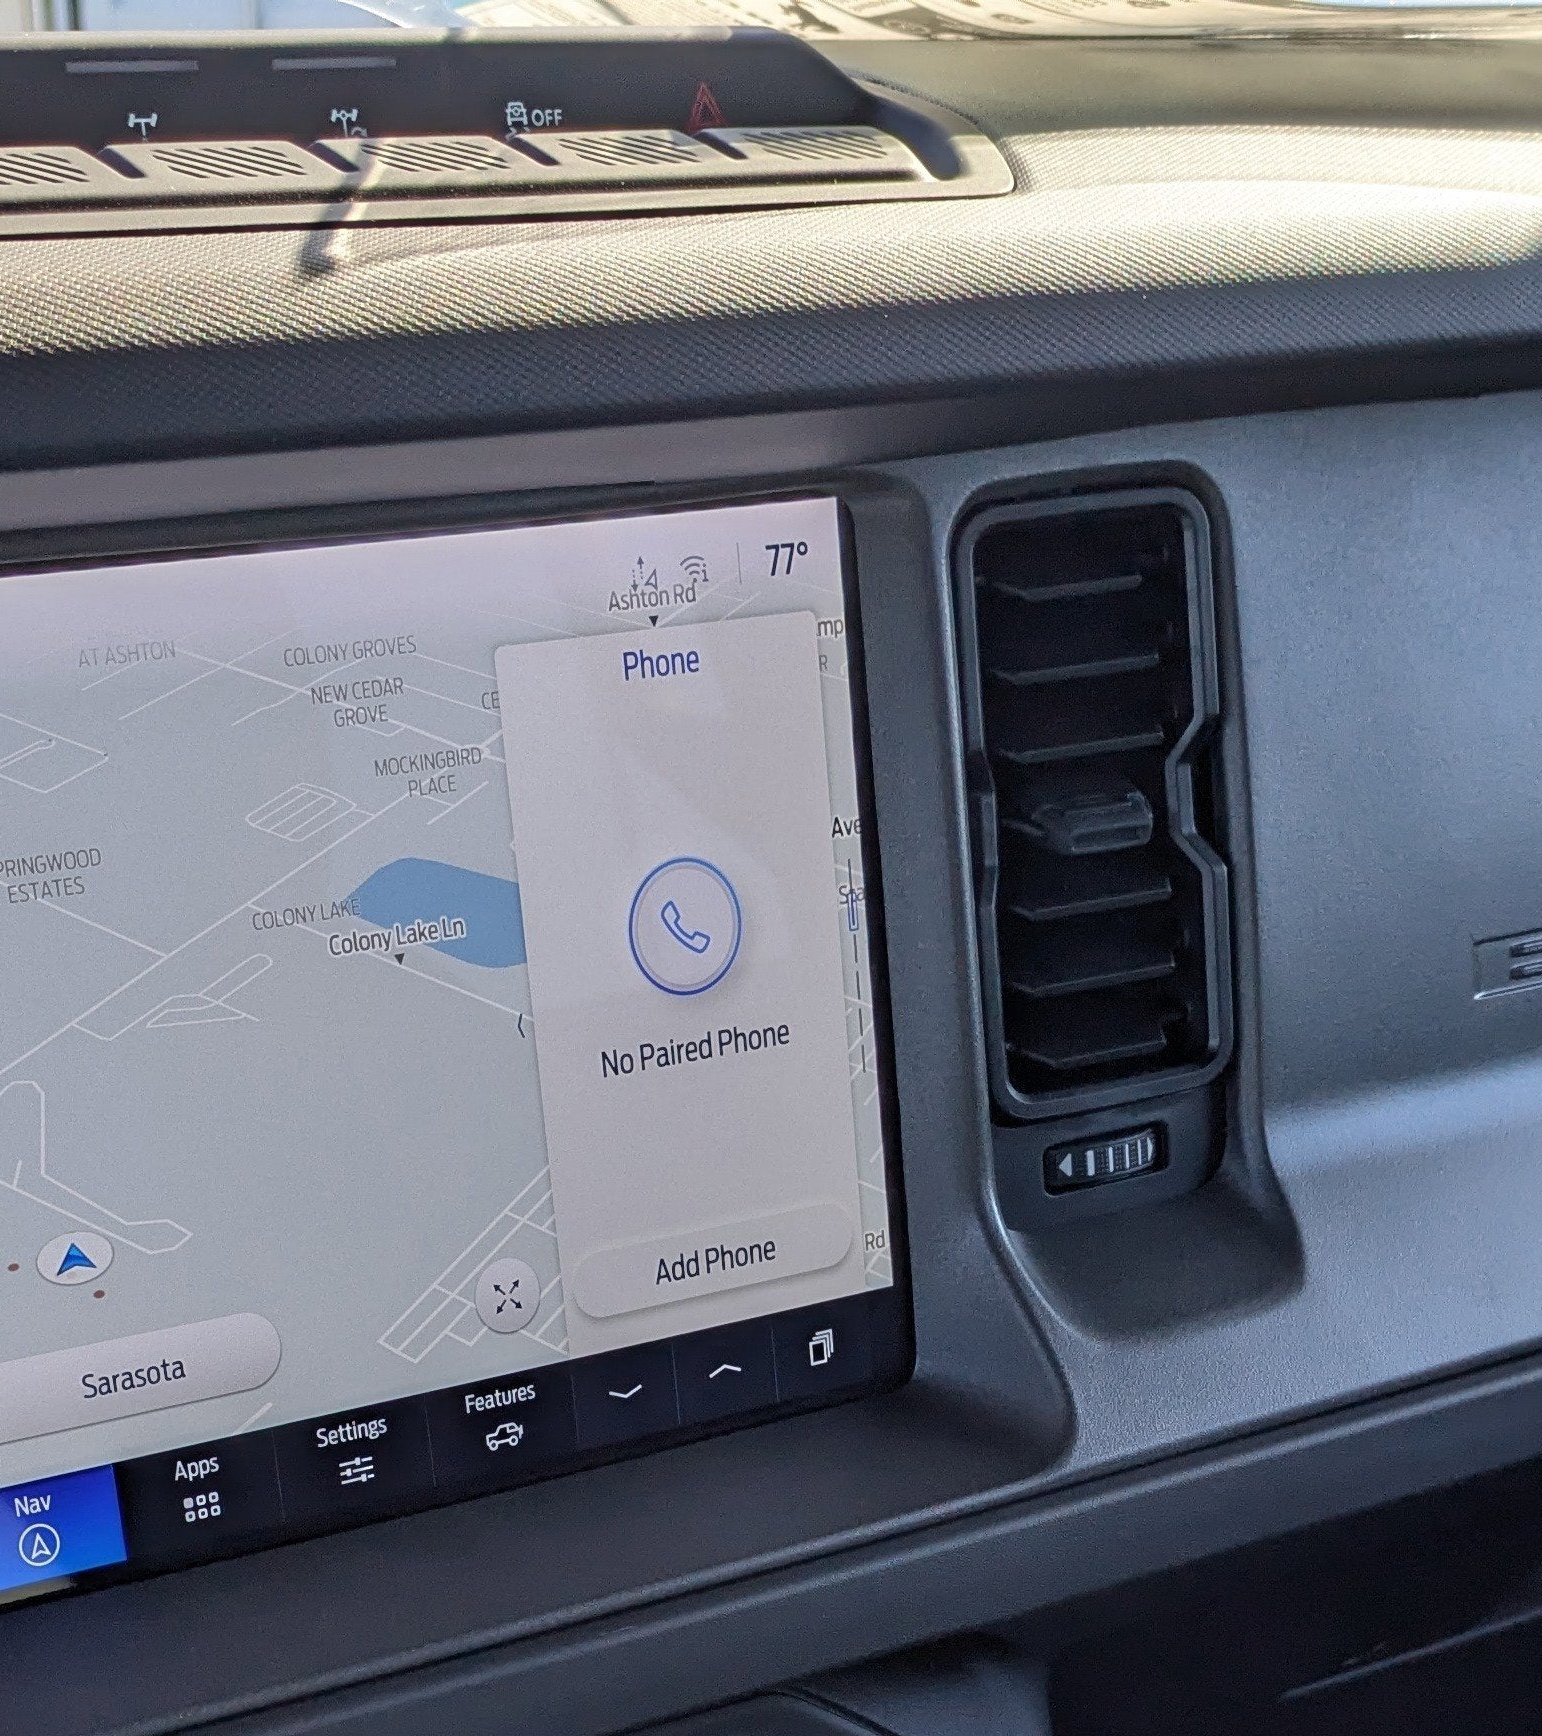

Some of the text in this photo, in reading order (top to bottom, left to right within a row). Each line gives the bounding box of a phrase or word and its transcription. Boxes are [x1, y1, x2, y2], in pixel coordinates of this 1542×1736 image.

[532, 108, 563, 127] OFF
[608, 582, 697, 612] Ashton Rd
[78, 640, 177, 668] AT ASHTON
[283, 634, 418, 667] COLONY GROVES
[622, 648, 701, 681] Phone
[310, 677, 405, 705] NEW CEDAR
[333, 702, 390, 728] GROVE
[373, 746, 483, 778] MOCKINGBIRD
[406, 774, 458, 799] PLACE
[6, 875, 87, 904] ESTATES
[252, 897, 362, 932] COLONY LAKE
[328, 916, 466, 957] Colony Lake Ln
[601, 1022, 791, 1079] No Paired Phone
[864, 1229, 886, 1252] Rd
[655, 1240, 777, 1286] Add Phone
[81, 1358, 187, 1400] Sarasota
[464, 1383, 537, 1414] Features
[316, 1416, 388, 1449] Settings
[174, 1456, 220, 1482] Apps
[13, 1493, 52, 1518] Nav
